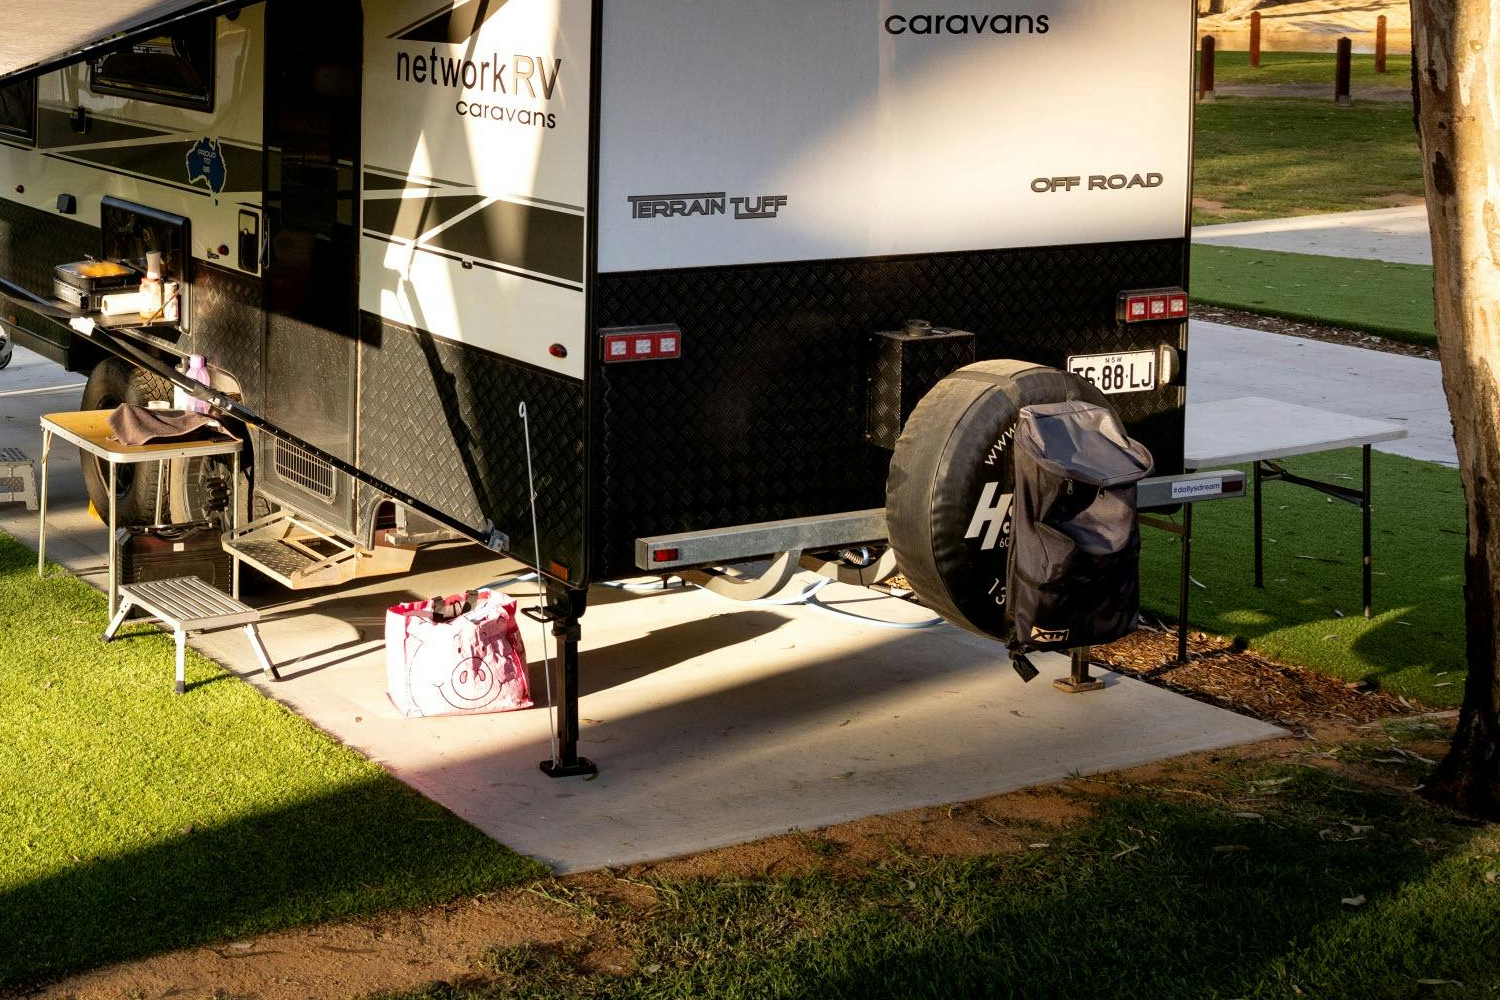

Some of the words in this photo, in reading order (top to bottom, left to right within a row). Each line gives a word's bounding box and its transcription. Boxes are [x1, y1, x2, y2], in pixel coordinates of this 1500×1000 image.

[884, 14, 1050, 35] caravans
[455, 100, 556, 129] caravans
[197, 149, 217, 159] PROUD
[1030, 176, 1081, 193] OFF
[1088, 172, 1164, 191] ROAD
[627, 192, 726, 219] TERRAIN
[729, 195, 788, 220] TUFF
[1105, 356, 1123, 364] NSW
[1173, 482, 1220, 494] #dollysdream
